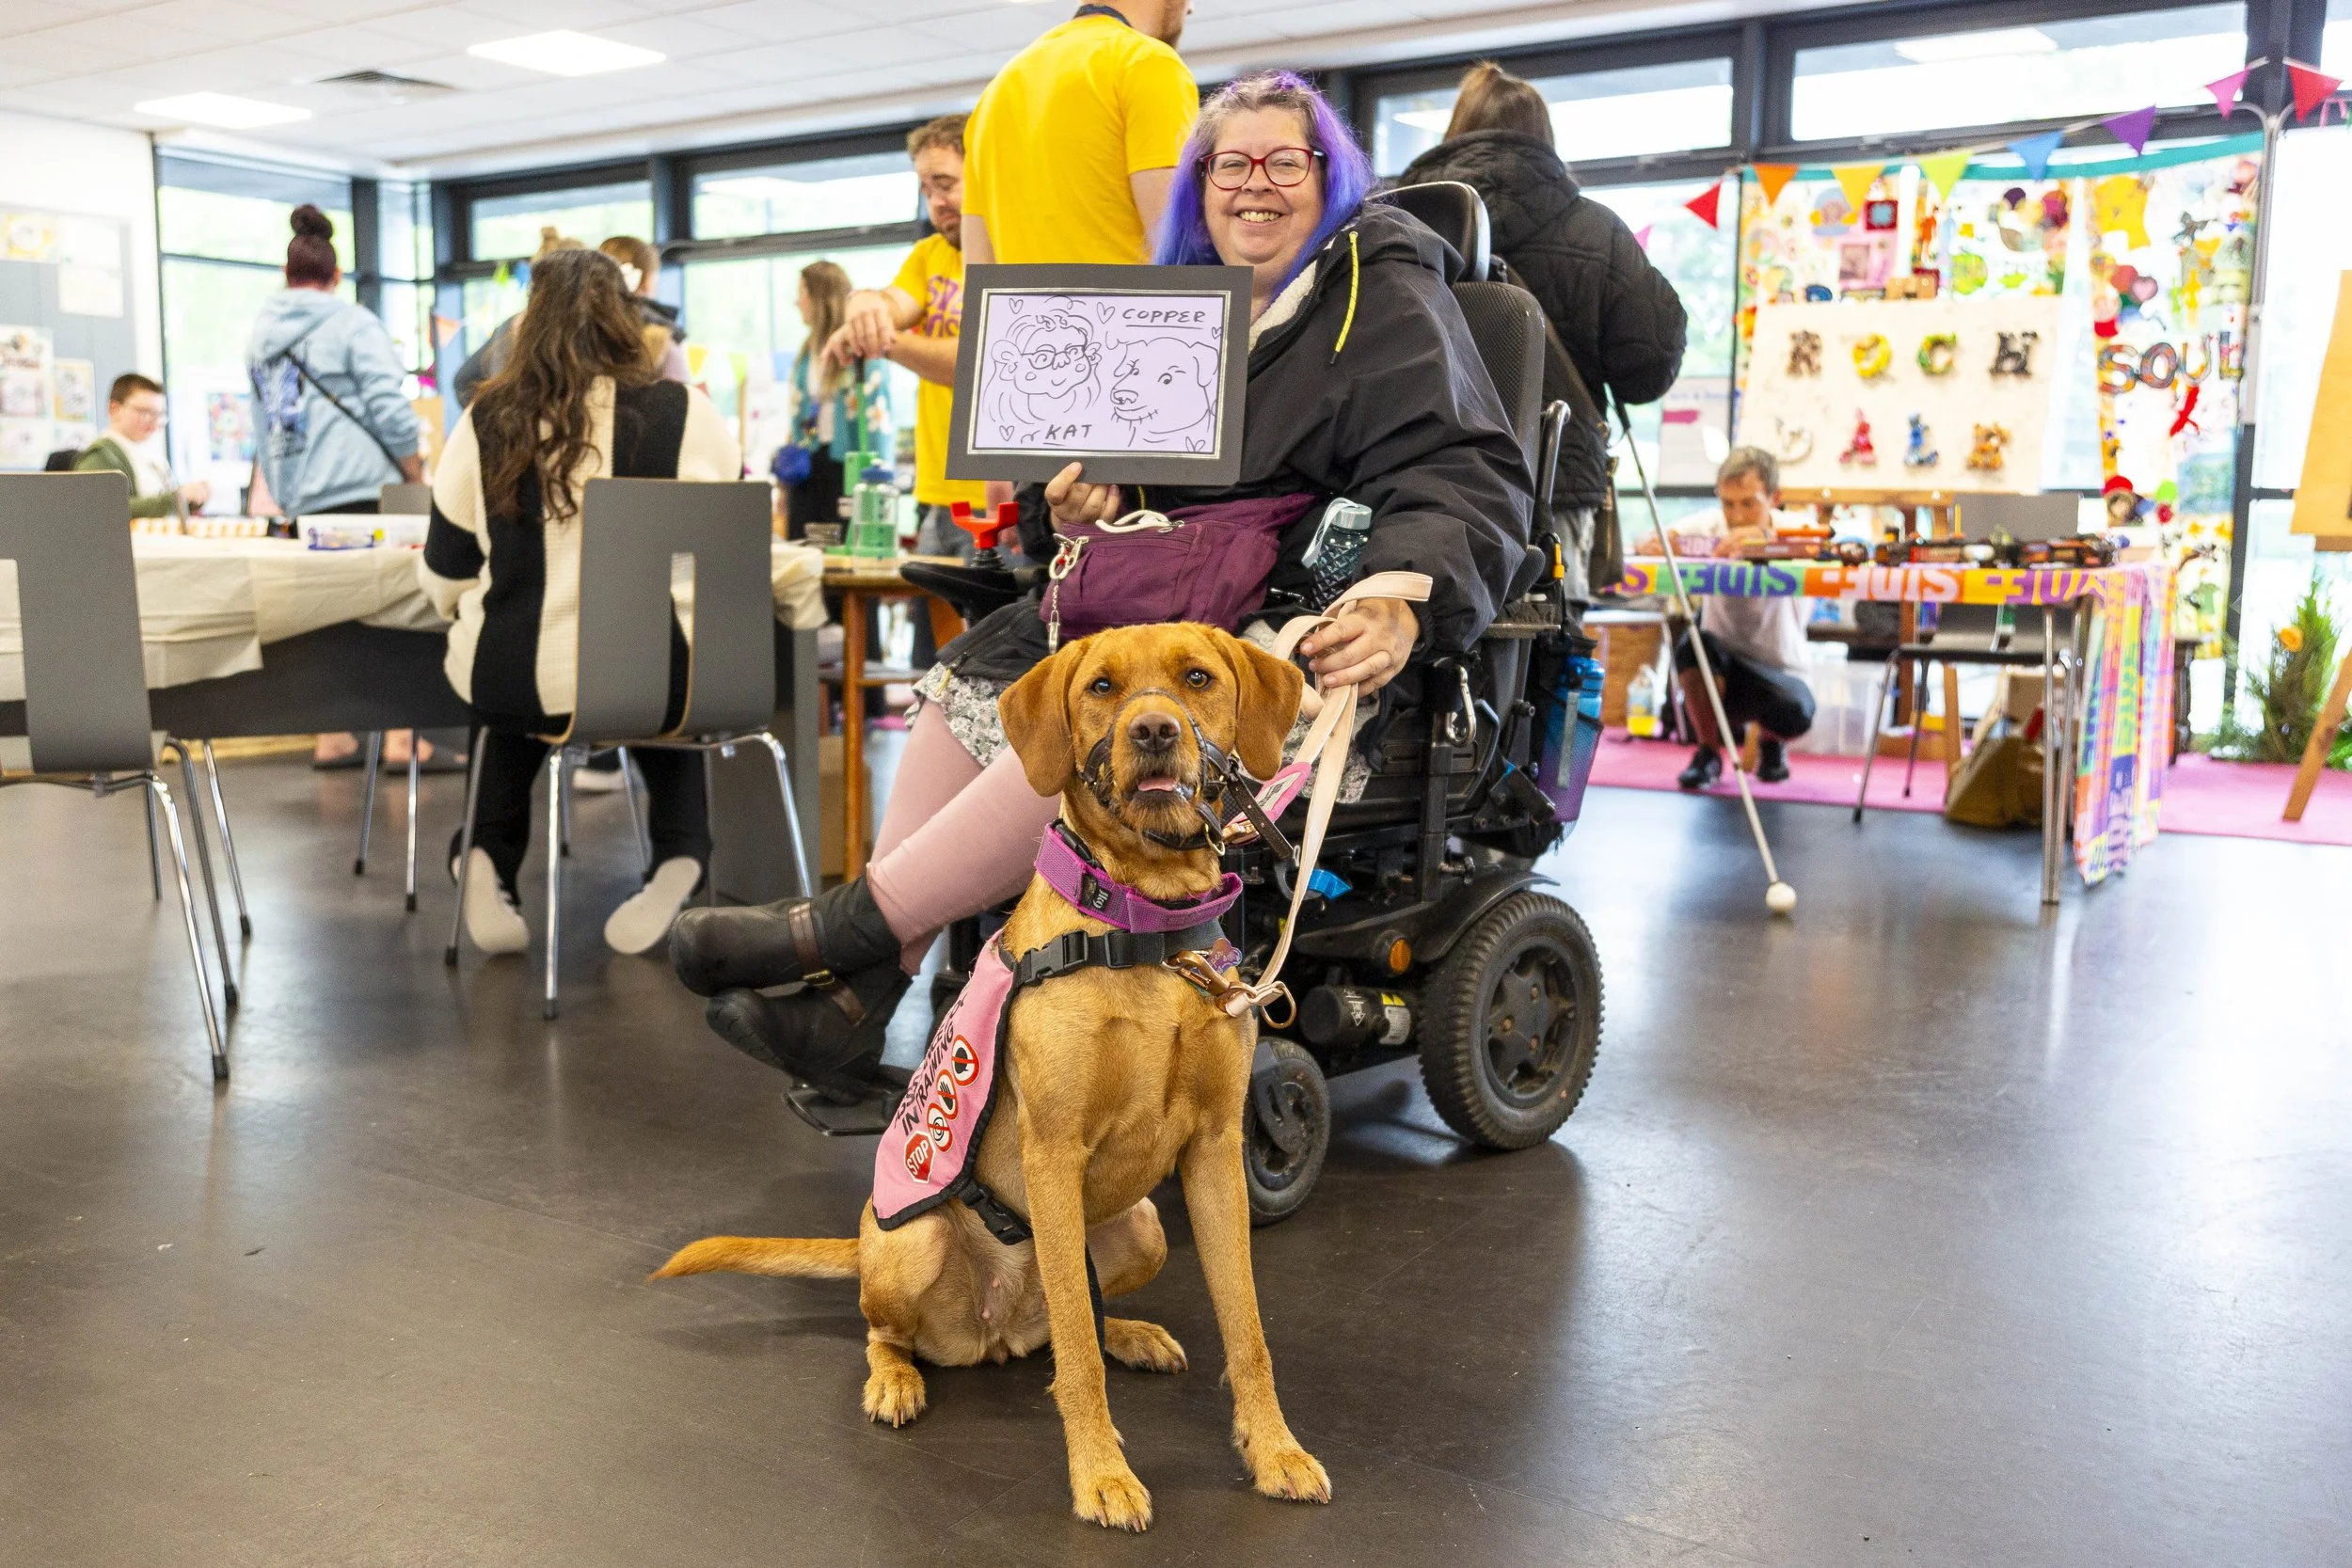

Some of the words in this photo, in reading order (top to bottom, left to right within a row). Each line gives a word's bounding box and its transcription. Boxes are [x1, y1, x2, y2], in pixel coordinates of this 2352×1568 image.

[1122, 309, 1206, 324] COPPER
[2099, 330, 2246, 394] SOUL
[1045, 423, 1092, 439] KAT
[901, 1105, 920, 1135] IN
[915, 1022, 954, 1114] TRAINING
[906, 1140, 929, 1175] STOP
